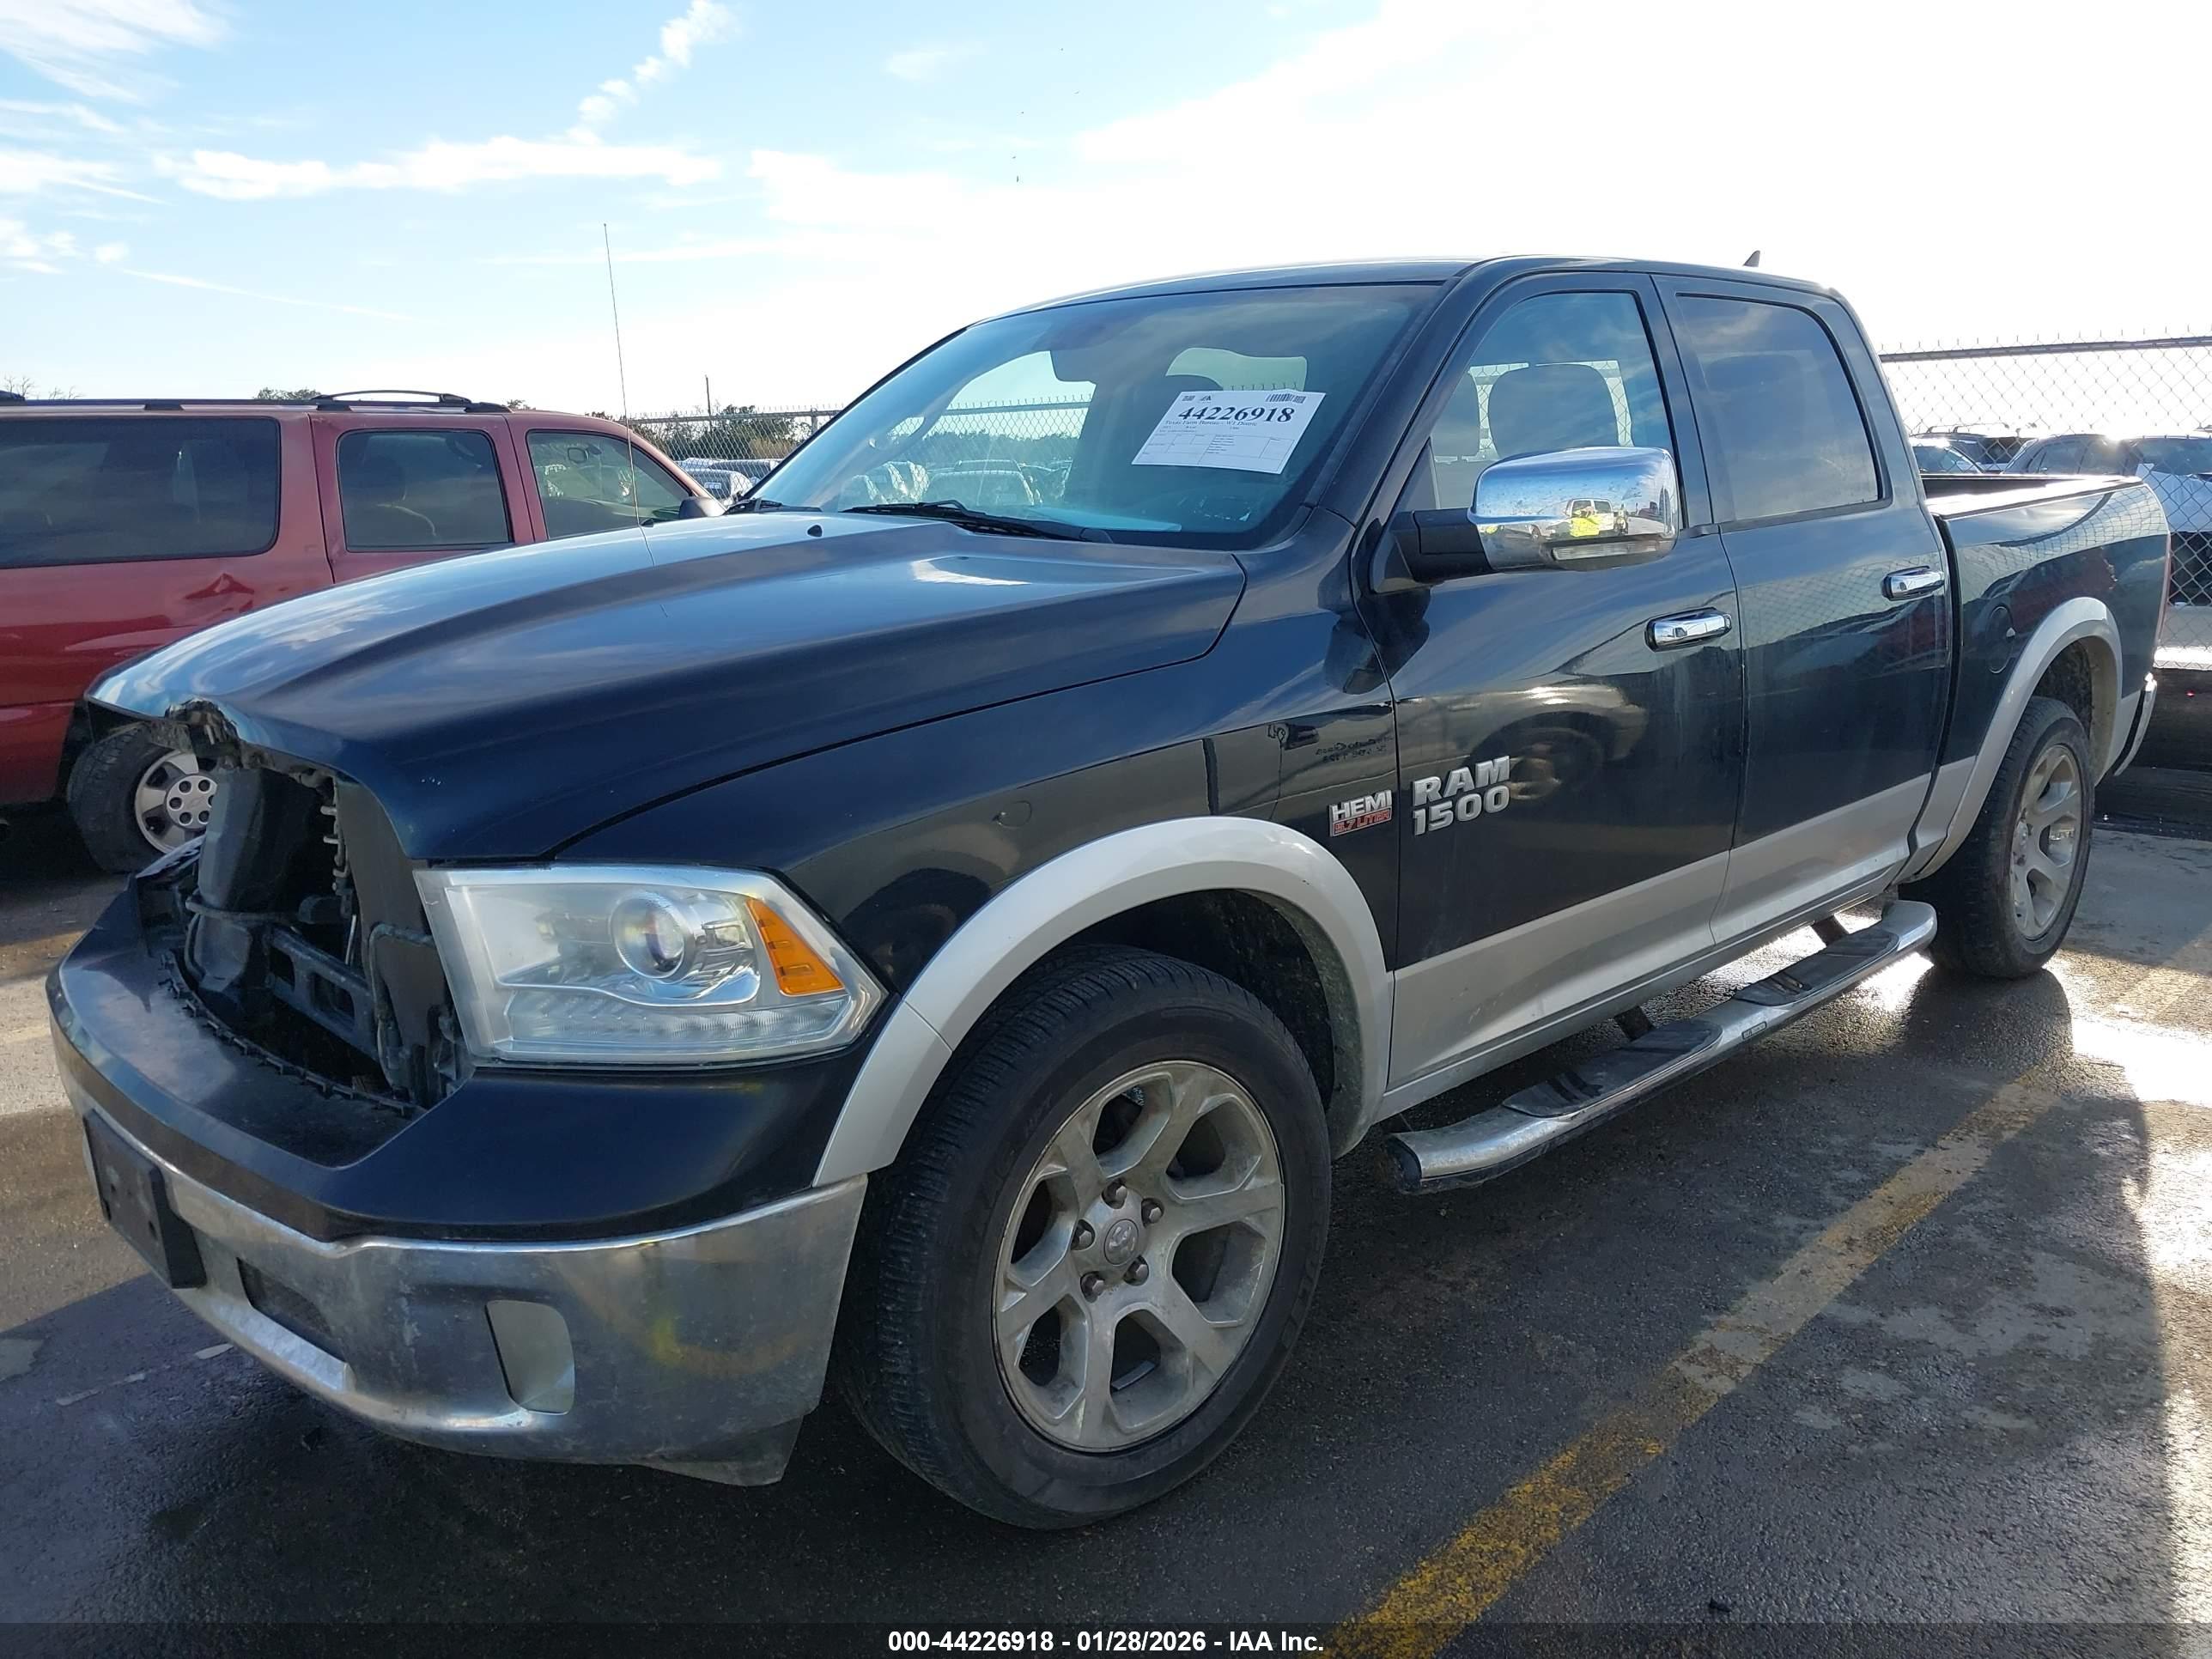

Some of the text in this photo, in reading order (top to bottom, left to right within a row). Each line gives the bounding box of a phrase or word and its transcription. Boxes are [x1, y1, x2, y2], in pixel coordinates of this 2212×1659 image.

[1178, 406, 1295, 422] 44226918
[1412, 756, 1510, 806] RAM
[1330, 789, 1392, 822] HEMI
[1413, 785, 1510, 836] 1500
[1334, 818, 1356, 834] 5.7
